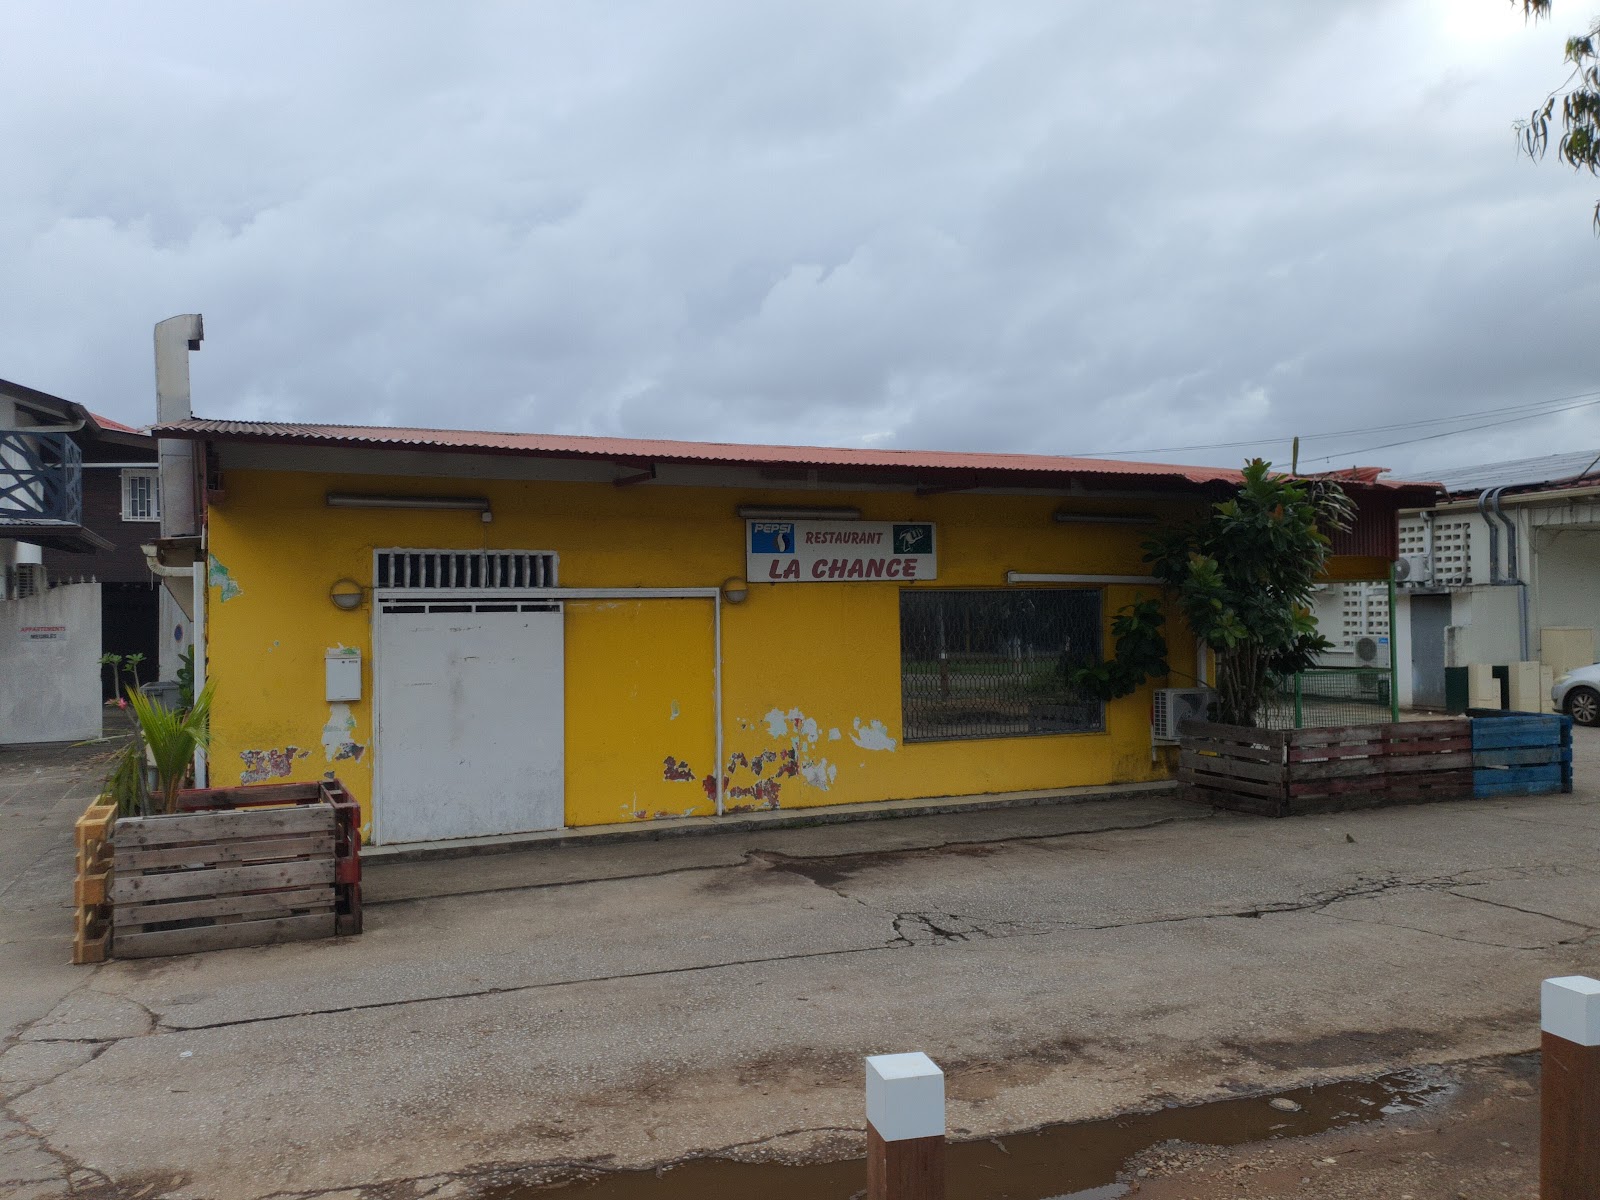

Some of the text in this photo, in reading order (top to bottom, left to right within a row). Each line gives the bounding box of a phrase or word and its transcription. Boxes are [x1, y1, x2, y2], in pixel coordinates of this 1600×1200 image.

[754, 523, 792, 534] PEPSI
[805, 531, 883, 545] RESTAURANT
[769, 558, 918, 579] LA CHANCE
